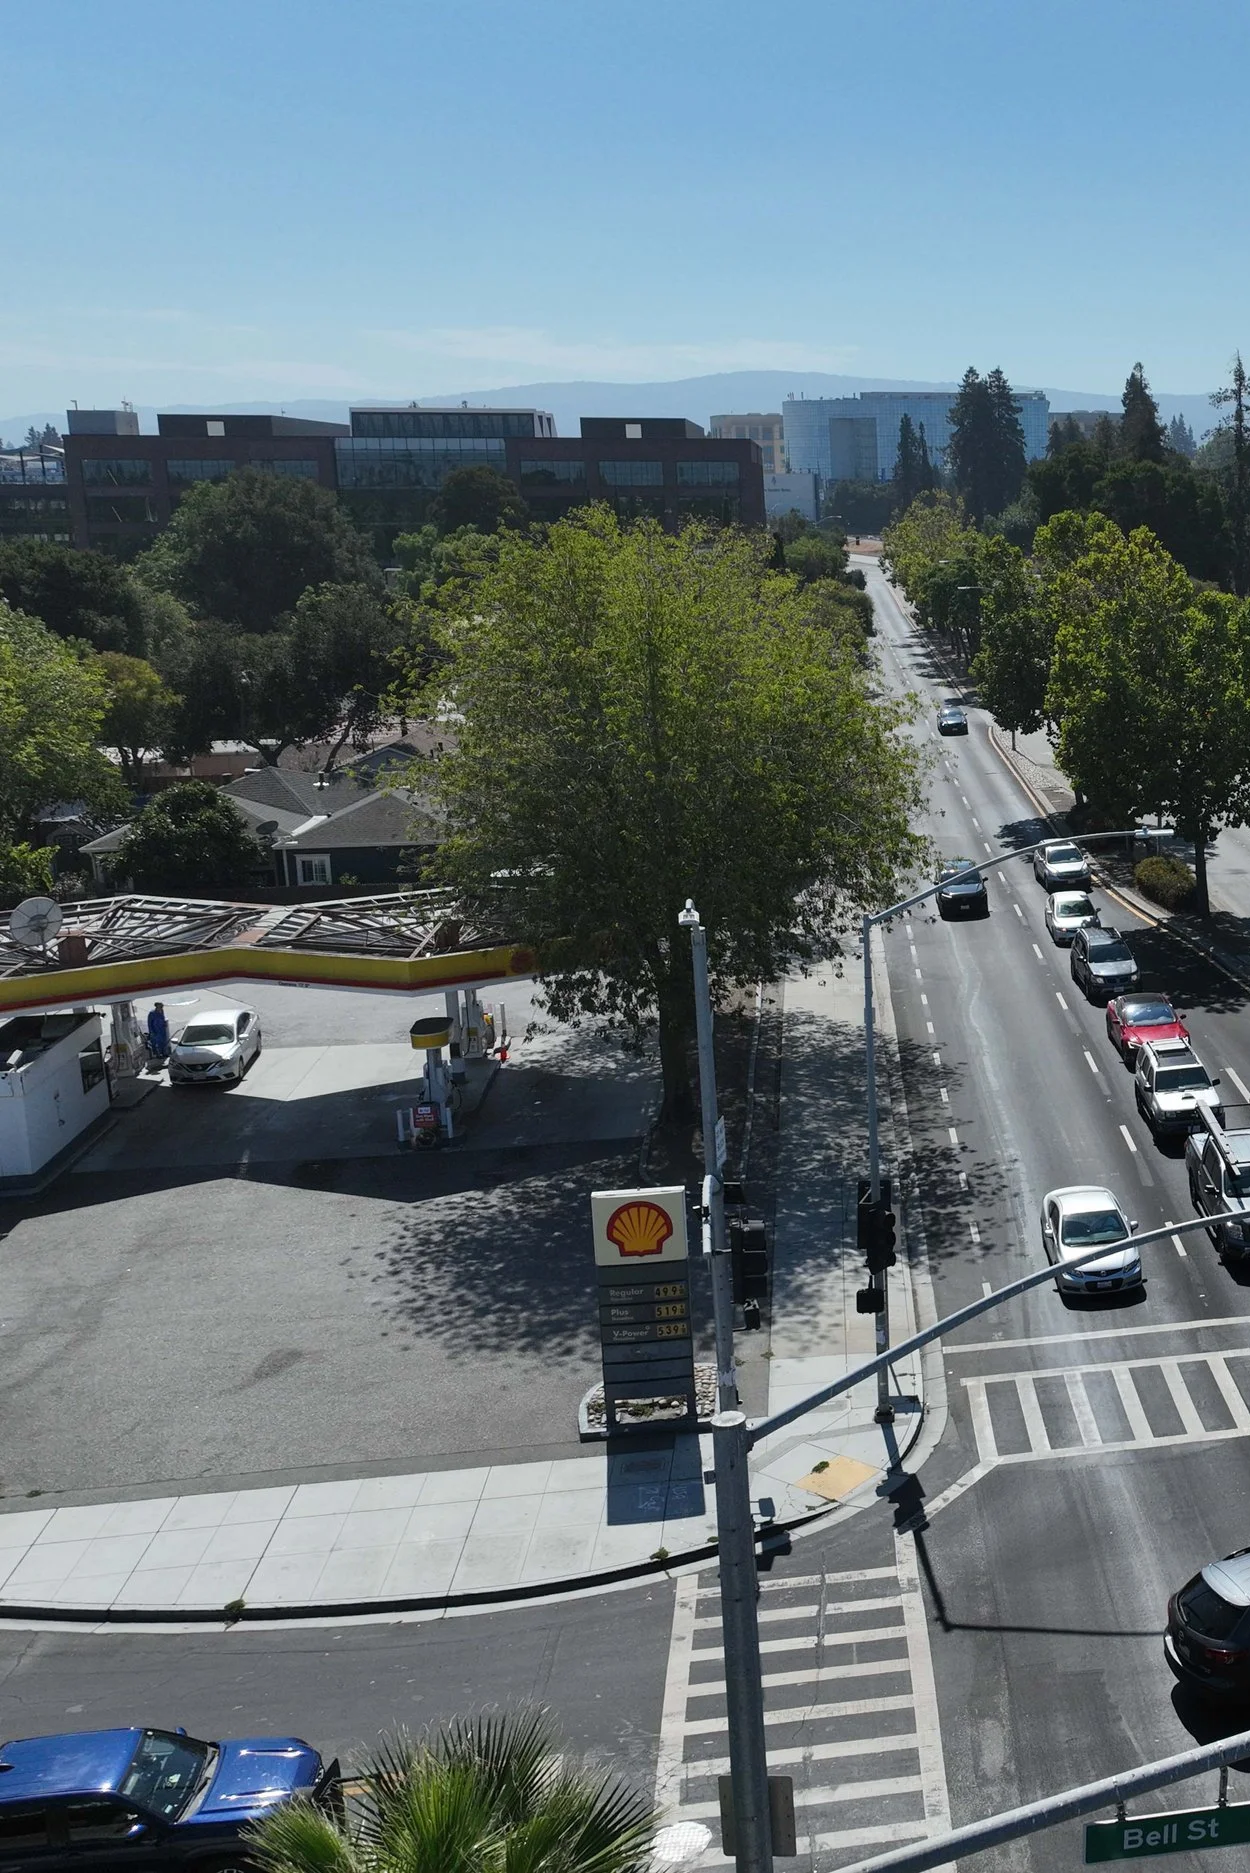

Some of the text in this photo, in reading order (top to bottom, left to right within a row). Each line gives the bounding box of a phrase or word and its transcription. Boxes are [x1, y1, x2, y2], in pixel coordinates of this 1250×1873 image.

[610, 1289, 644, 1297] Regular
[613, 1329, 649, 1337] V-Power
[1124, 1818, 1219, 1850] Bell St
